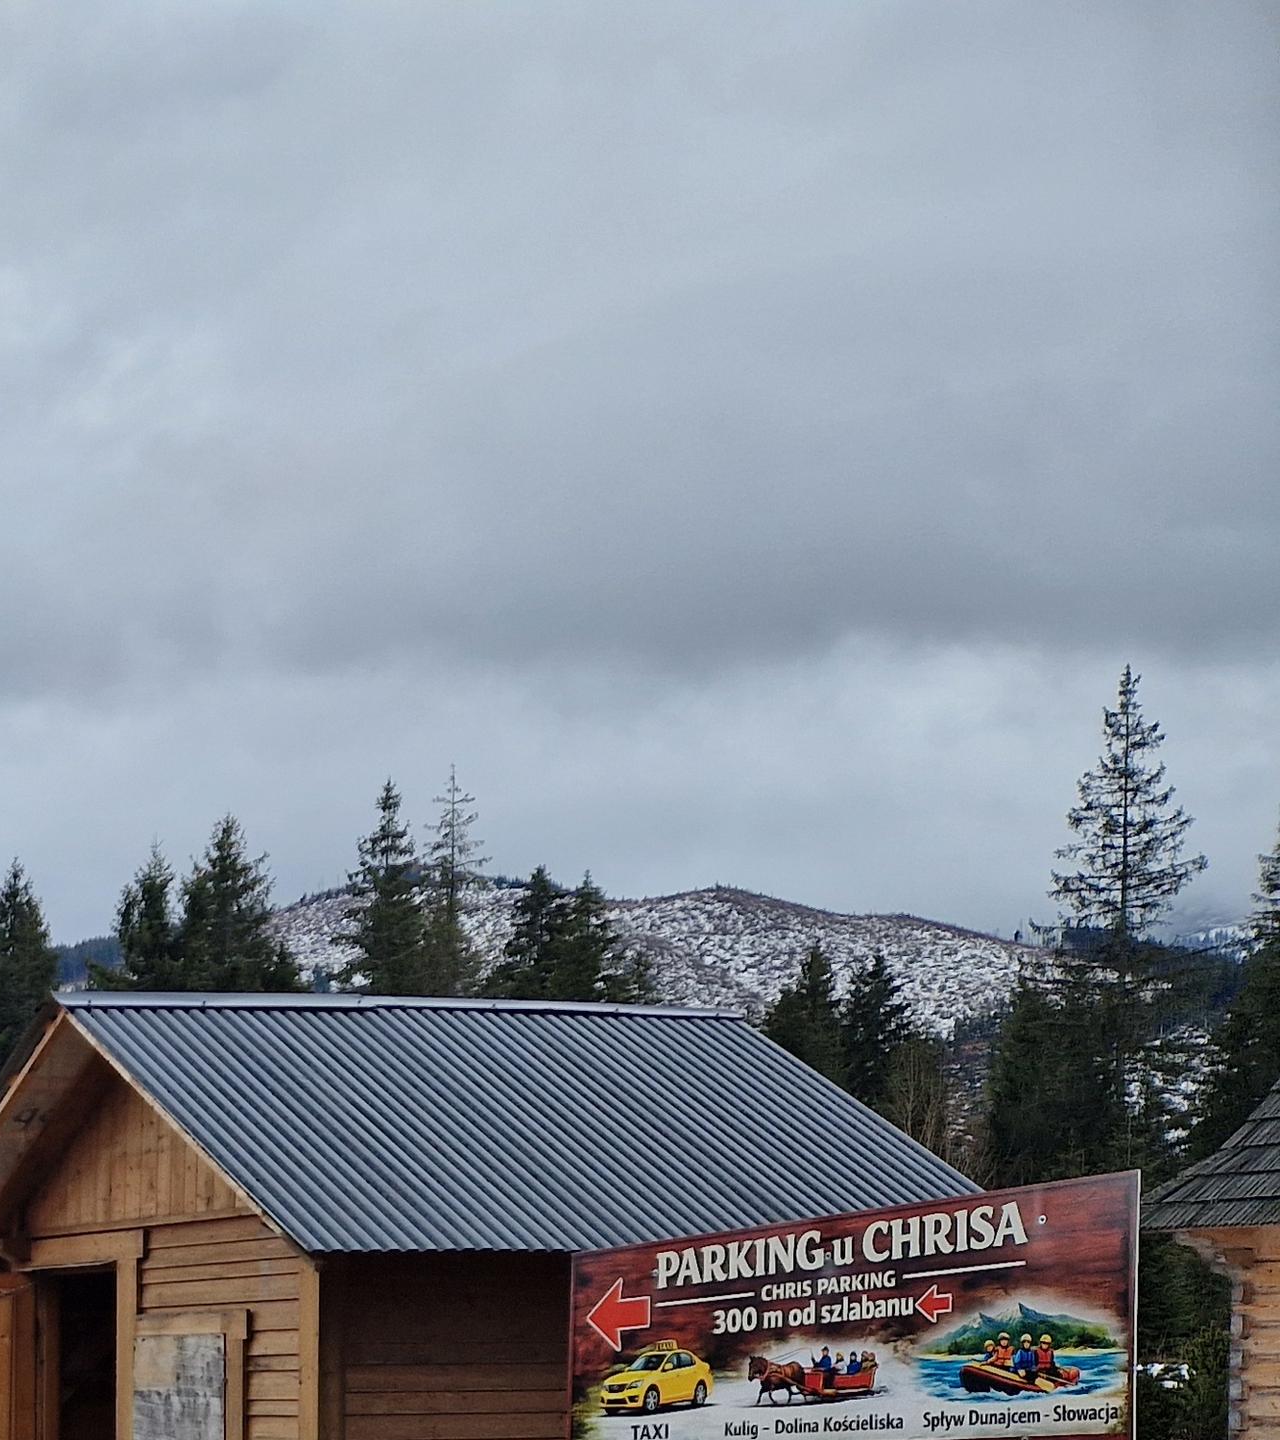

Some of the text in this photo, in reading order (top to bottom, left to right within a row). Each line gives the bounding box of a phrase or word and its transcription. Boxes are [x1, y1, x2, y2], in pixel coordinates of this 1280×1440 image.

[655, 1201, 1029, 1290] PARKING u CHRISA
[760, 1271, 897, 1301] CHRIS PARKING
[712, 1293, 915, 1335] 300 m od szlabanu
[630, 1423, 670, 1440] TAXI
[724, 1421, 759, 1440] Kulig
[774, 1417, 819, 1434] Dolina
[823, 1412, 904, 1432] Kościeliska
[923, 1410, 965, 1432] Spływ
[968, 1407, 1041, 1428] Dunajcem
[1052, 1402, 1119, 1425] Słowacja
